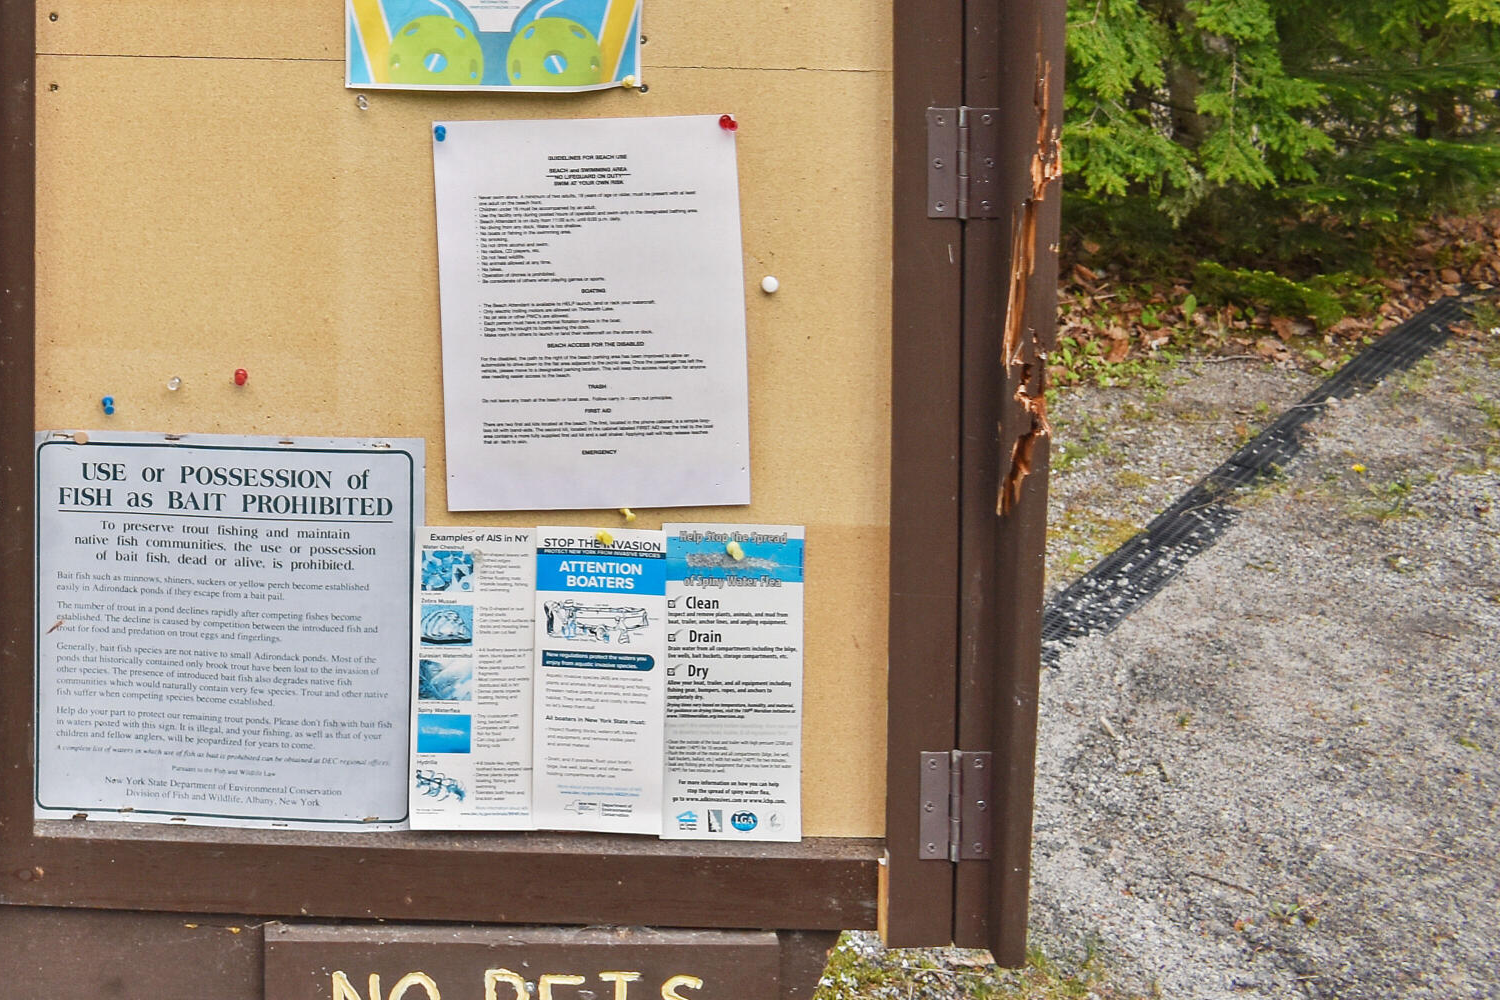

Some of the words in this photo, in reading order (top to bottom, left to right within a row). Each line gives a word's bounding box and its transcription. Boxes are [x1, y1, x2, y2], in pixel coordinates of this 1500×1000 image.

[81, 463, 126, 481] USE
[141, 467, 164, 482] or
[180, 466, 332, 488] POSSESSION
[346, 469, 369, 489] of
[58, 487, 111, 506] FISH
[126, 492, 152, 508] as
[168, 491, 226, 511] BAIT
[242, 494, 392, 515] PROHIBITED
[100, 520, 116, 531] To
[123, 522, 174, 533] preserve
[182, 524, 208, 534] trout
[217, 525, 258, 538] fishing
[265, 527, 288, 537] and
[297, 528, 350, 539] maintain
[429, 533, 473, 542] Examples
[474, 533, 484, 541] of
[485, 534, 502, 542] AIS
[514, 534, 528, 542] NY
[679, 530, 703, 542] Help
[705, 531, 729, 542] Stop
[730, 532, 749, 542] the
[750, 532, 788, 544] Spread
[74, 534, 108, 545] native
[117, 535, 138, 546] fish
[234, 542, 253, 553] the
[260, 544, 281, 553] use
[289, 545, 300, 553] or
[309, 544, 375, 556] possession
[544, 538, 575, 547] STOP
[578, 538, 600, 548] THE
[604, 540, 661, 551] NVASION
[95, 550, 106, 560] of
[115, 550, 137, 561] bait
[177, 553, 206, 565] dead
[214, 557, 226, 566] or
[272, 557, 283, 568] is
[290, 559, 354, 571] prohibited.
[558, 561, 642, 575] ATTENTION
[566, 575, 634, 589] BOATERS
[683, 576, 695, 586] of
[697, 576, 724, 589] Spiny
[726, 576, 757, 587] Water
[760, 577, 782, 587] Flea
[57, 584, 79, 593] easily
[93, 584, 138, 594] Adirondack
[140, 586, 163, 596] ponds
[174, 587, 191, 597] they
[193, 589, 220, 598] escape
[222, 591, 241, 599] from
[250, 591, 265, 600] bait
[267, 592, 285, 601] pail.
[685, 595, 719, 609] Clean
[689, 629, 721, 642] Drain
[687, 665, 708, 680] Dry
[105, 776, 123, 785] New
[126, 777, 145, 786] York
[148, 778, 168, 787] State
[170, 780, 216, 791] Department
[218, 782, 227, 791] of
[229, 783, 287, 794] Environmental
[289, 786, 342, 796] Conservation
[735, 815, 756, 825] LGA
